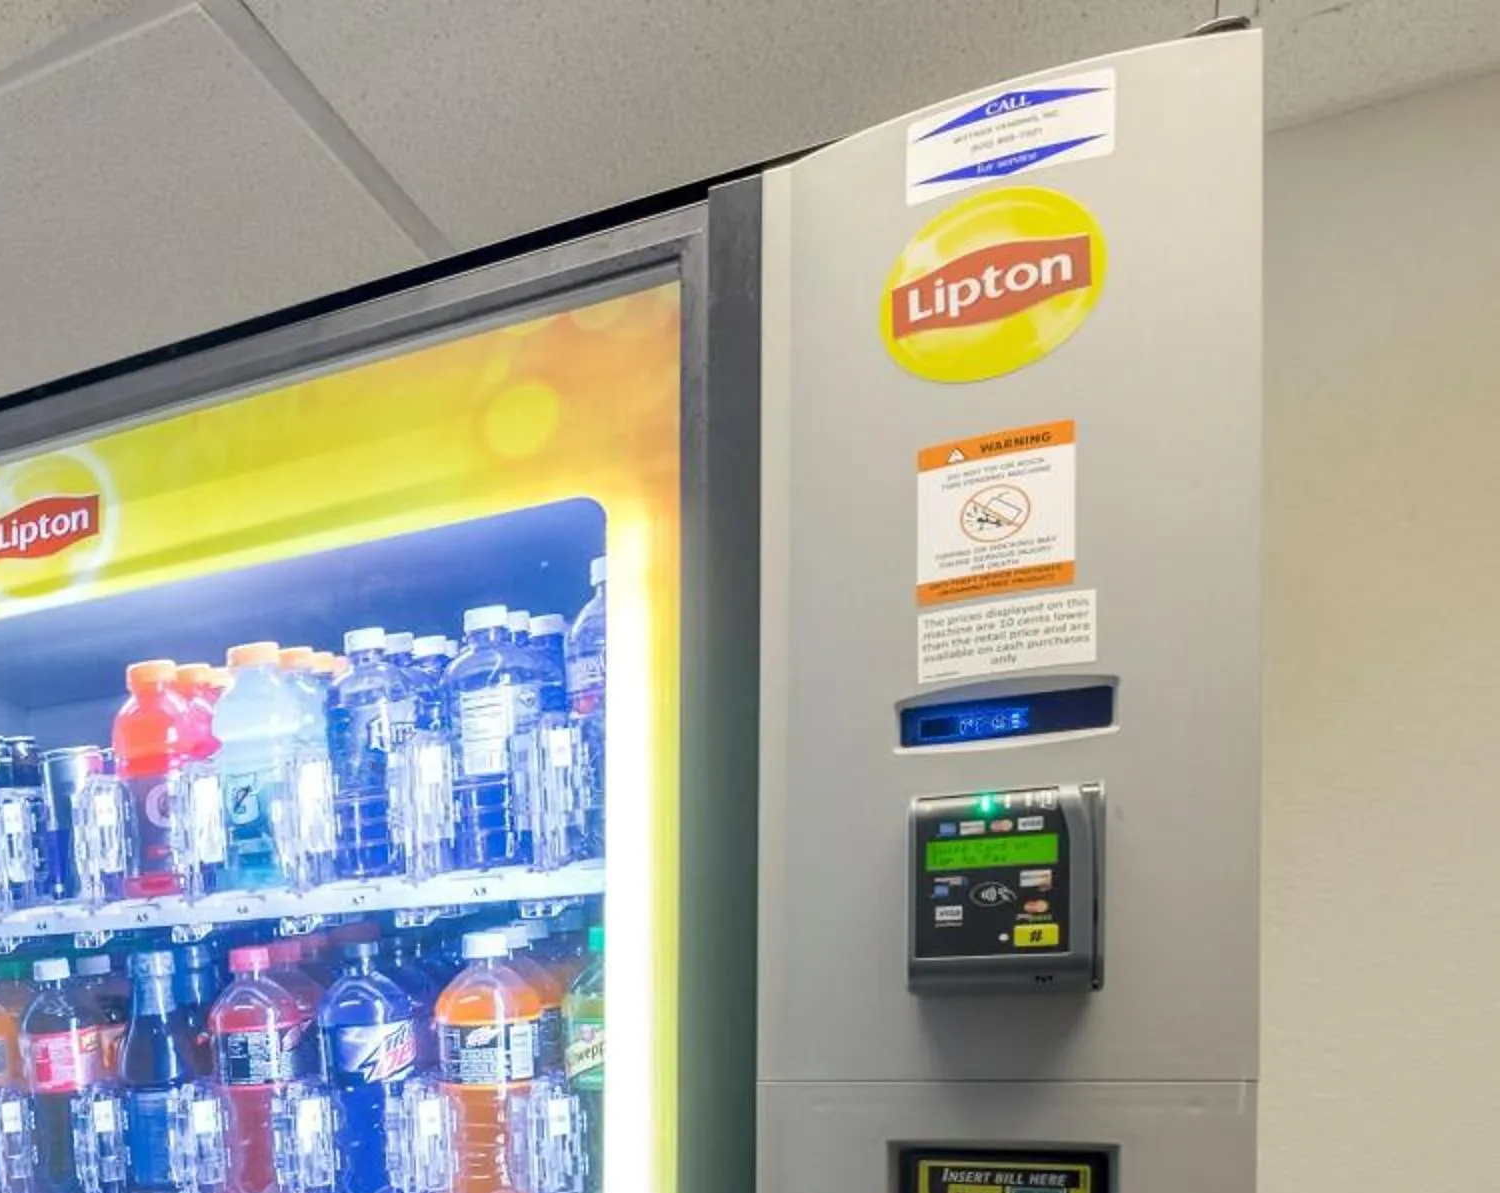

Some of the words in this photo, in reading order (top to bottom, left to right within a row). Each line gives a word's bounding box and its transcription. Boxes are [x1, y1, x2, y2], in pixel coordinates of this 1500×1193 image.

[985, 95, 1032, 115] CALL
[908, 253, 1073, 322] Lipton
[980, 431, 1052, 452] WARNING
[923, 618, 945, 629] The
[947, 612, 982, 626] prices
[985, 602, 1044, 619] displayed
[1047, 601, 1063, 611] on
[1066, 598, 1090, 609] this
[924, 626, 973, 640] machine
[976, 623, 996, 631] are
[1000, 618, 1015, 629] 10
[1018, 614, 1050, 627] cents
[1053, 610, 1089, 621] lower
[922, 641, 949, 653] than
[951, 637, 971, 647] the
[973, 631, 1006, 643] retail
[1009, 628, 1041, 641] price
[1043, 623, 1067, 635] and
[1069, 621, 1091, 631] are
[923, 646, 974, 663] available
[977, 645, 993, 655] on
[996, 640, 1025, 653] cash
[1027, 634, 1090, 651] purchases
[990, 654, 1018, 665] only
[942, 1167, 991, 1184] INSERT
[994, 1170, 1025, 1185] BILL
[1029, 1172, 1069, 1186] HERE
